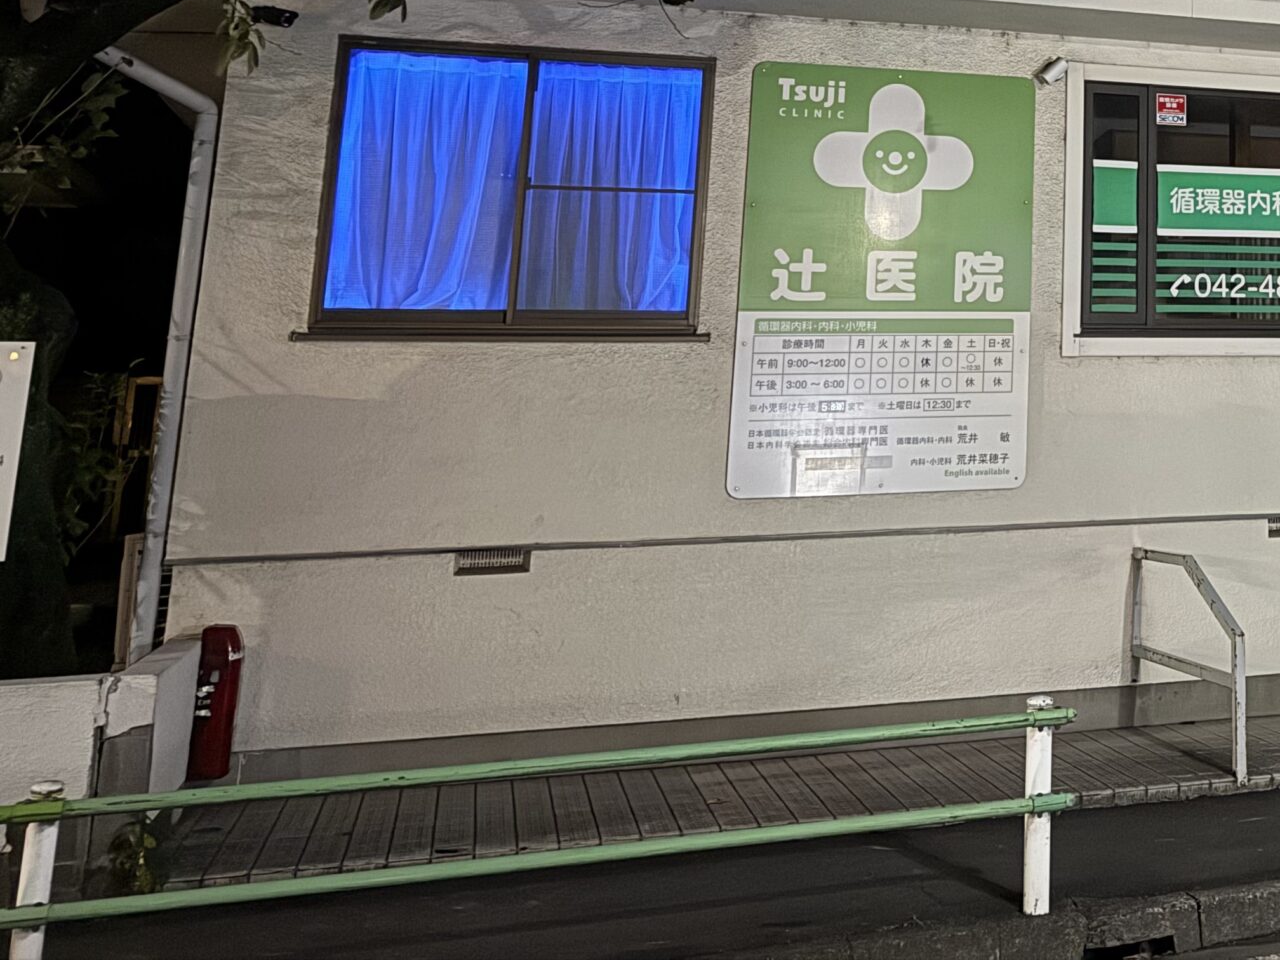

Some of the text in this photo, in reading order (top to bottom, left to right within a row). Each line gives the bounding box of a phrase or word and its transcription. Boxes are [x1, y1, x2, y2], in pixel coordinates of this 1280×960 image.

[778, 77, 846, 108] Tsuji
[779, 107, 845, 119] CLINIC
[1158, 114, 1184, 123] SECOM
[769, 248, 1005, 303] 辻医院
[782, 338, 824, 349] 診療時間
[856, 338, 865, 349] 月
[878, 338, 888, 349] 火
[900, 338, 910, 349] 水
[921, 338, 932, 349] 木
[943, 338, 953, 349] 金
[966, 338, 976, 349] 土
[756, 358, 778, 369] 午前
[921, 357, 931, 368] 休
[993, 356, 1004, 367] 休
[755, 379, 777, 390] 午後
[920, 377, 930, 388] 休
[965, 377, 975, 388] 休
[993, 377, 1003, 387] 休
[926, 400, 952, 409] 12:30
[956, 400, 972, 409] まで
[957, 432, 979, 444] 荒井
[944, 468, 1010, 478] English available
